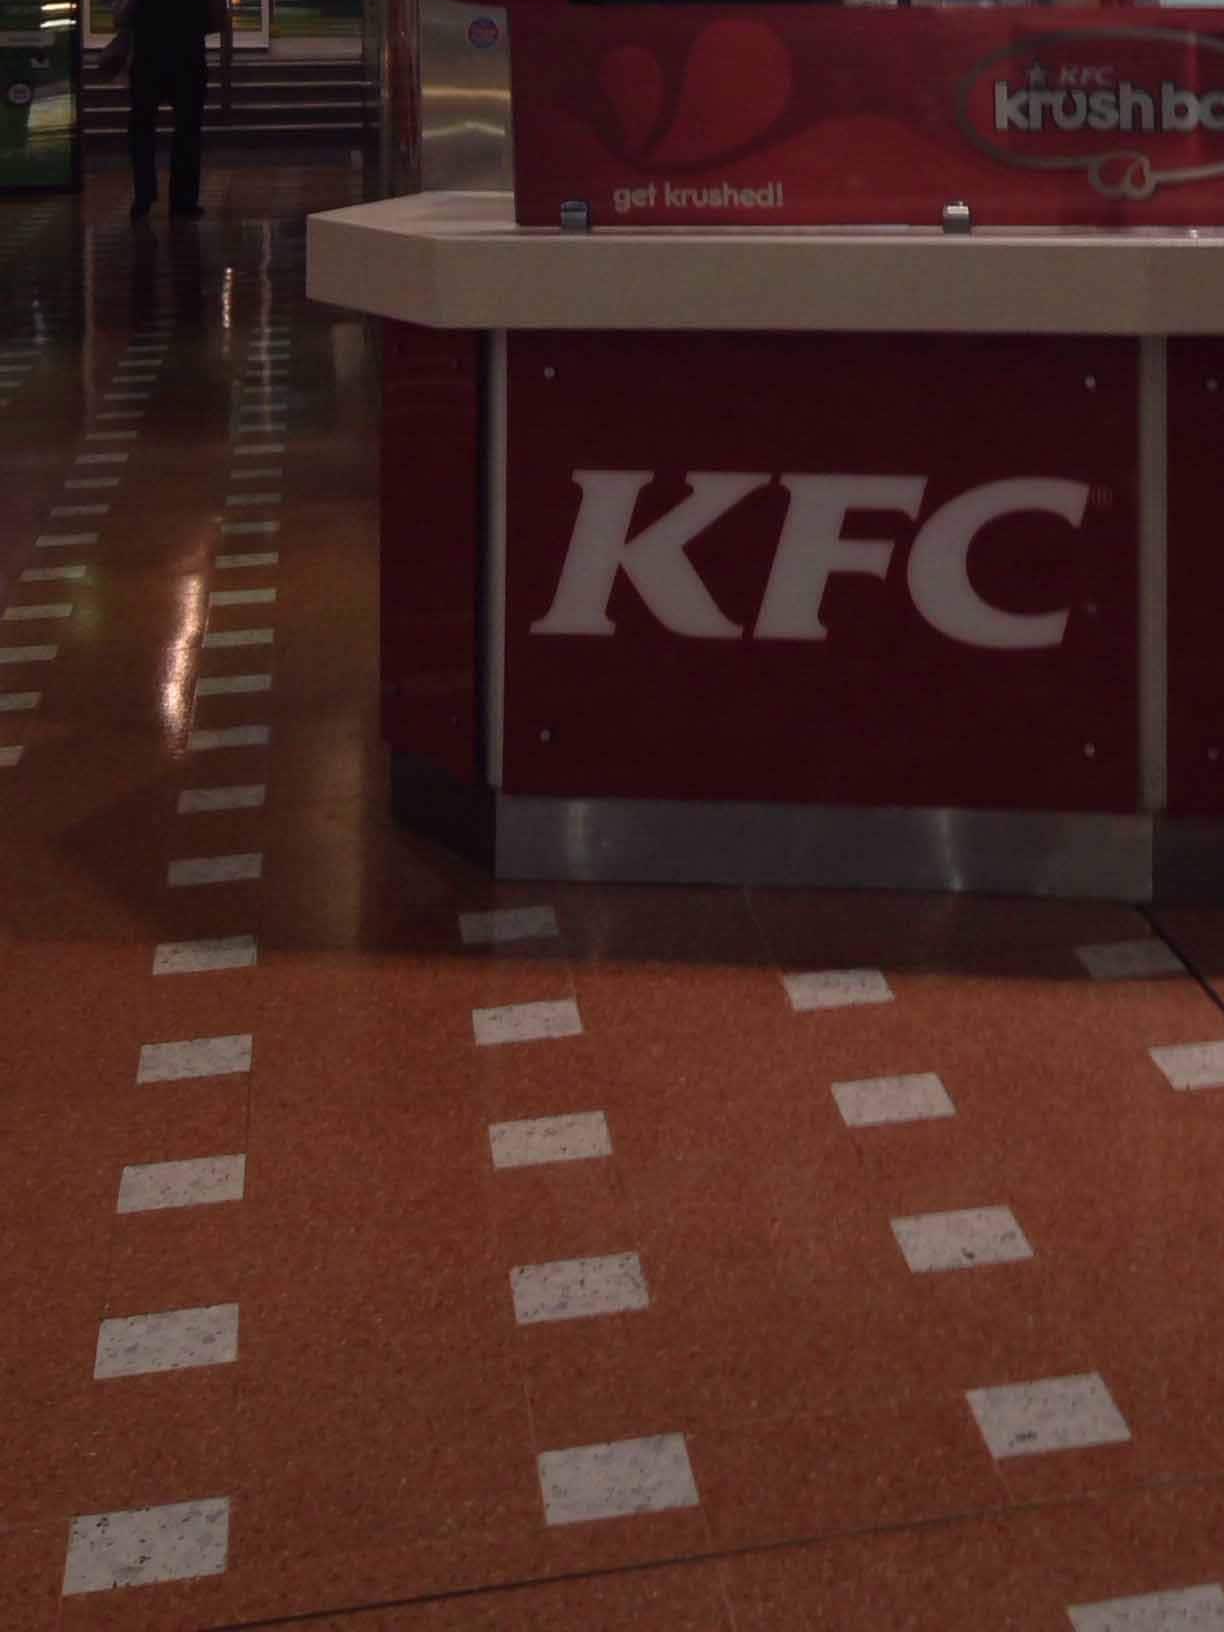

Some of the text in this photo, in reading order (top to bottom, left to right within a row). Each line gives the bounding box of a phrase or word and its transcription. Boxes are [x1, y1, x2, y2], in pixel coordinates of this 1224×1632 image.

[613, 180, 785, 212] get krushed!
[530, 468, 1090, 649] KFC
